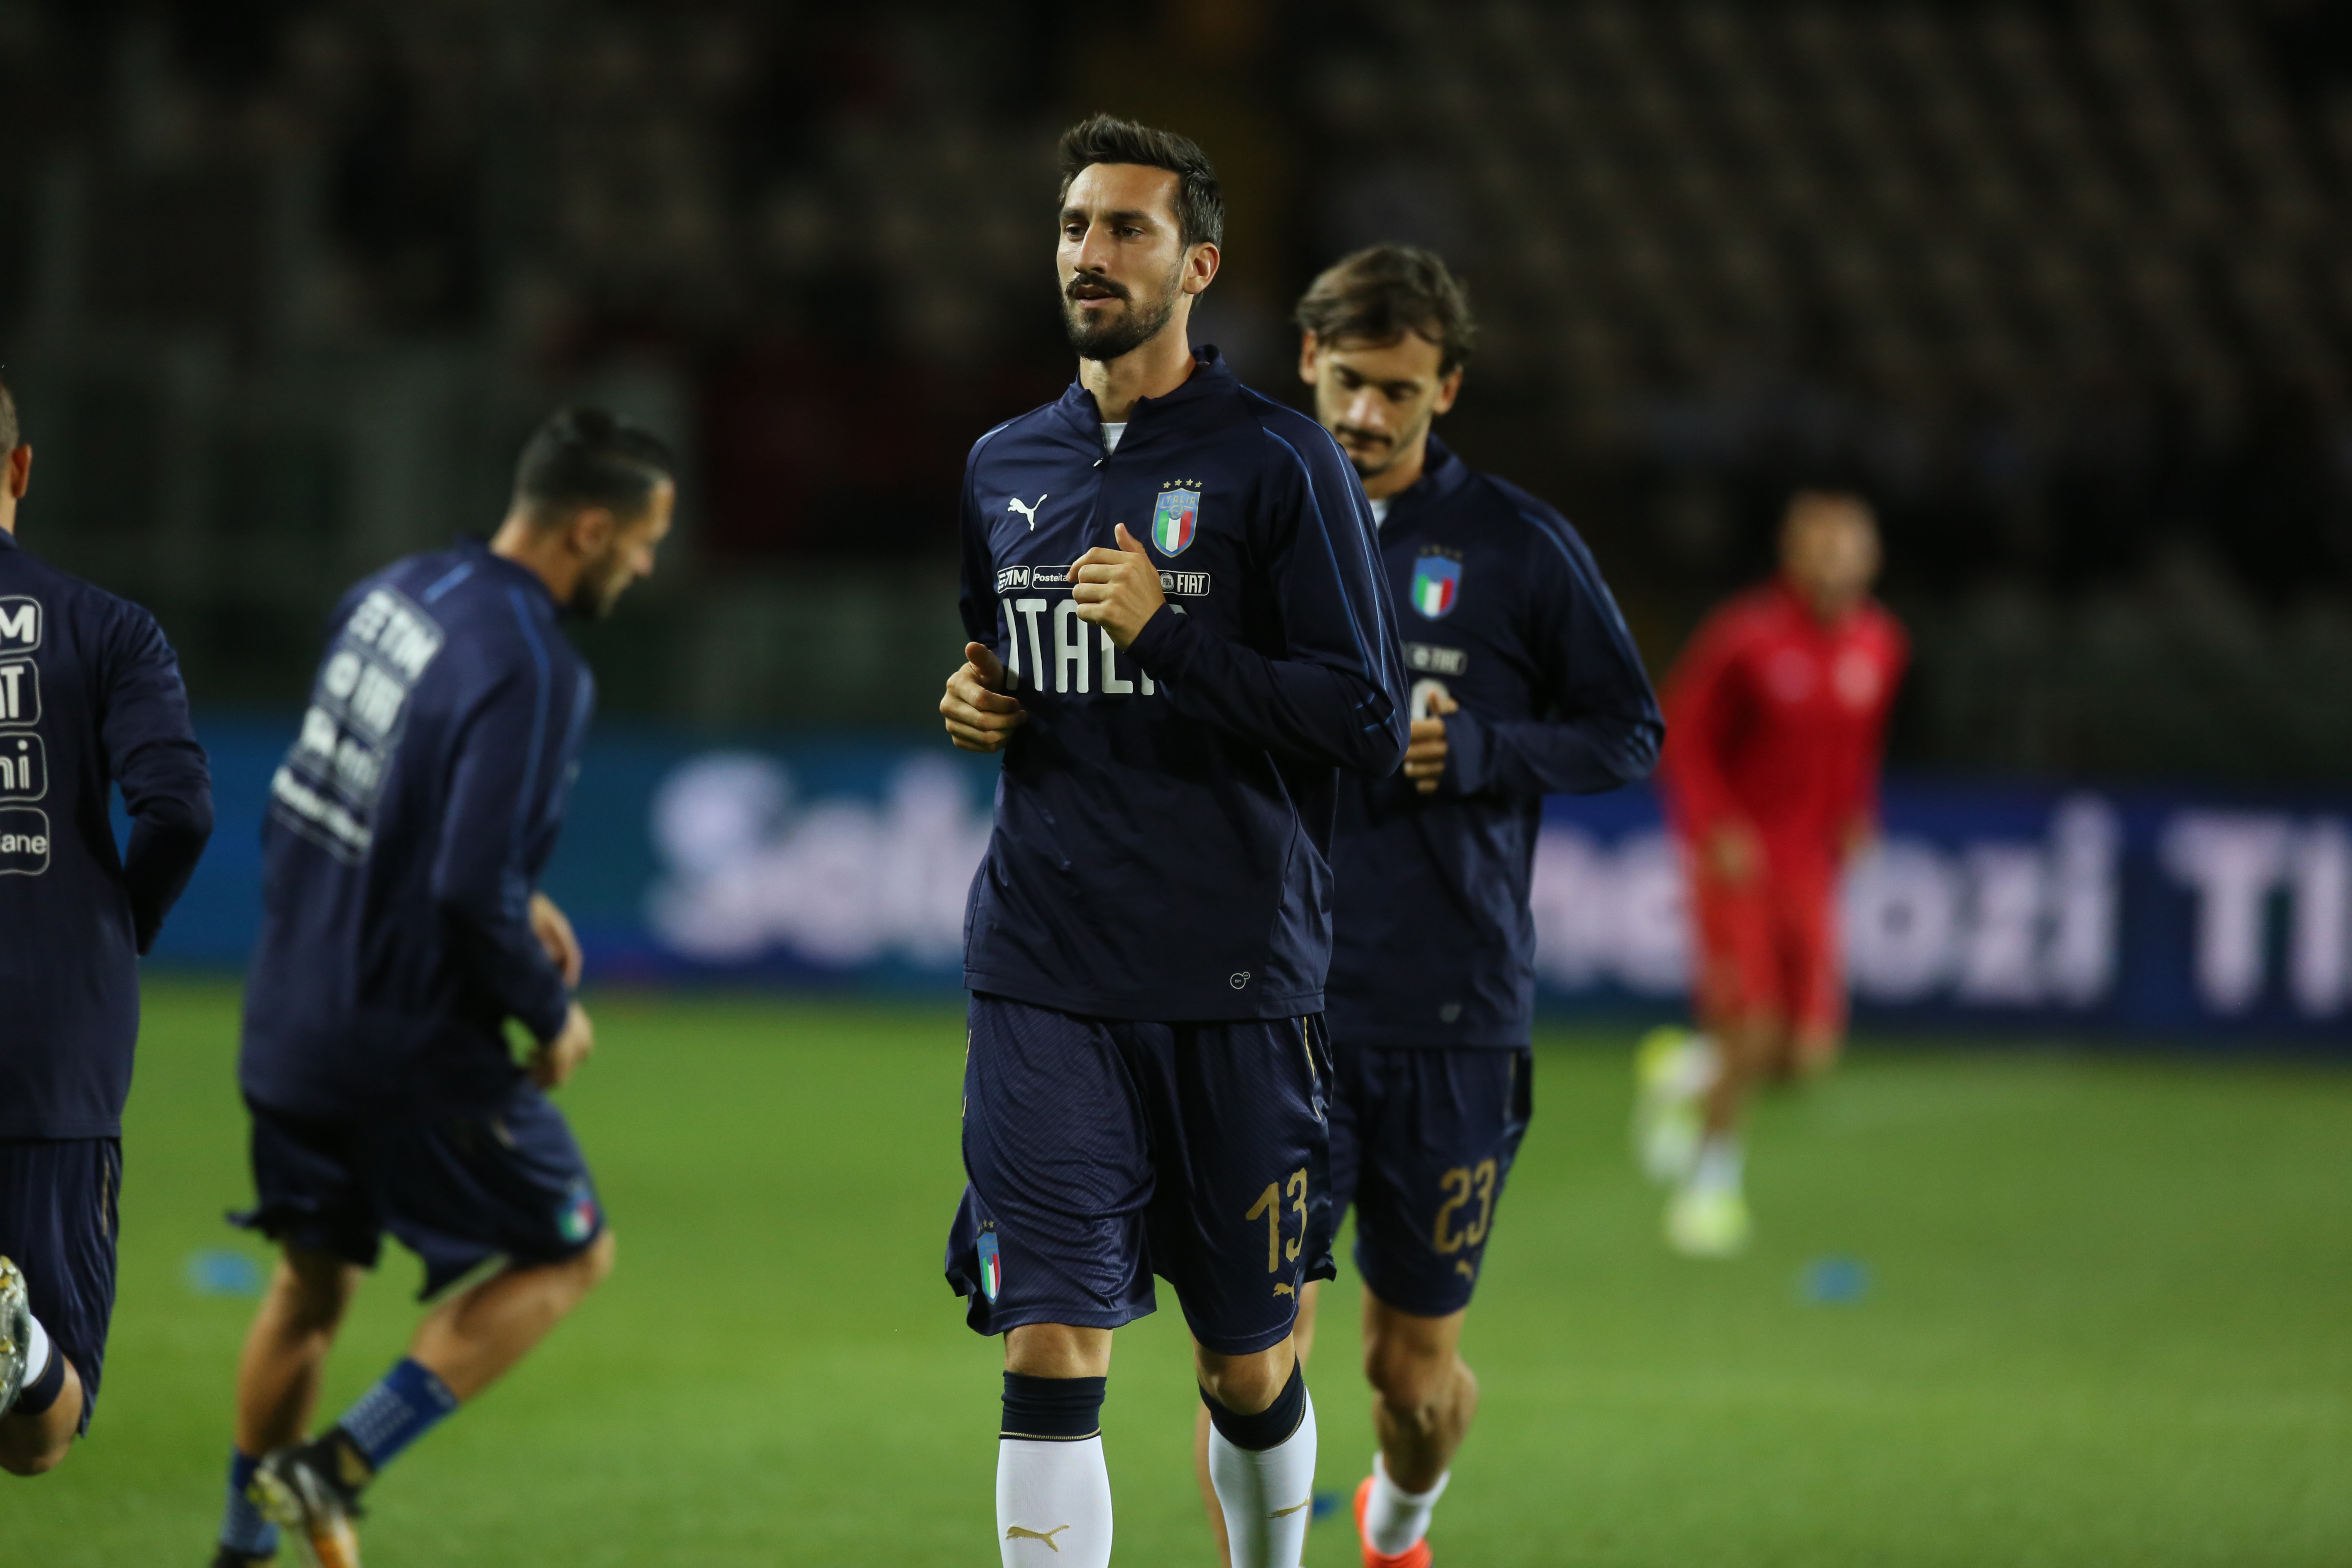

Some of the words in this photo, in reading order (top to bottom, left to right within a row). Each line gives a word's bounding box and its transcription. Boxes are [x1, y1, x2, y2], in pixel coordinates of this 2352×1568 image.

[1161, 495, 1196, 505] ITALIA
[1004, 570, 1028, 586] TIM
[1033, 573, 1068, 582] Posteita
[1177, 574, 1205, 593] FIAT
[0, 605, 35, 643] M
[1003, 598, 1187, 695] ITAL
[0, 834, 47, 855] ane
[1433, 1158, 1497, 1253] 23
[1246, 1167, 1307, 1273] 13
